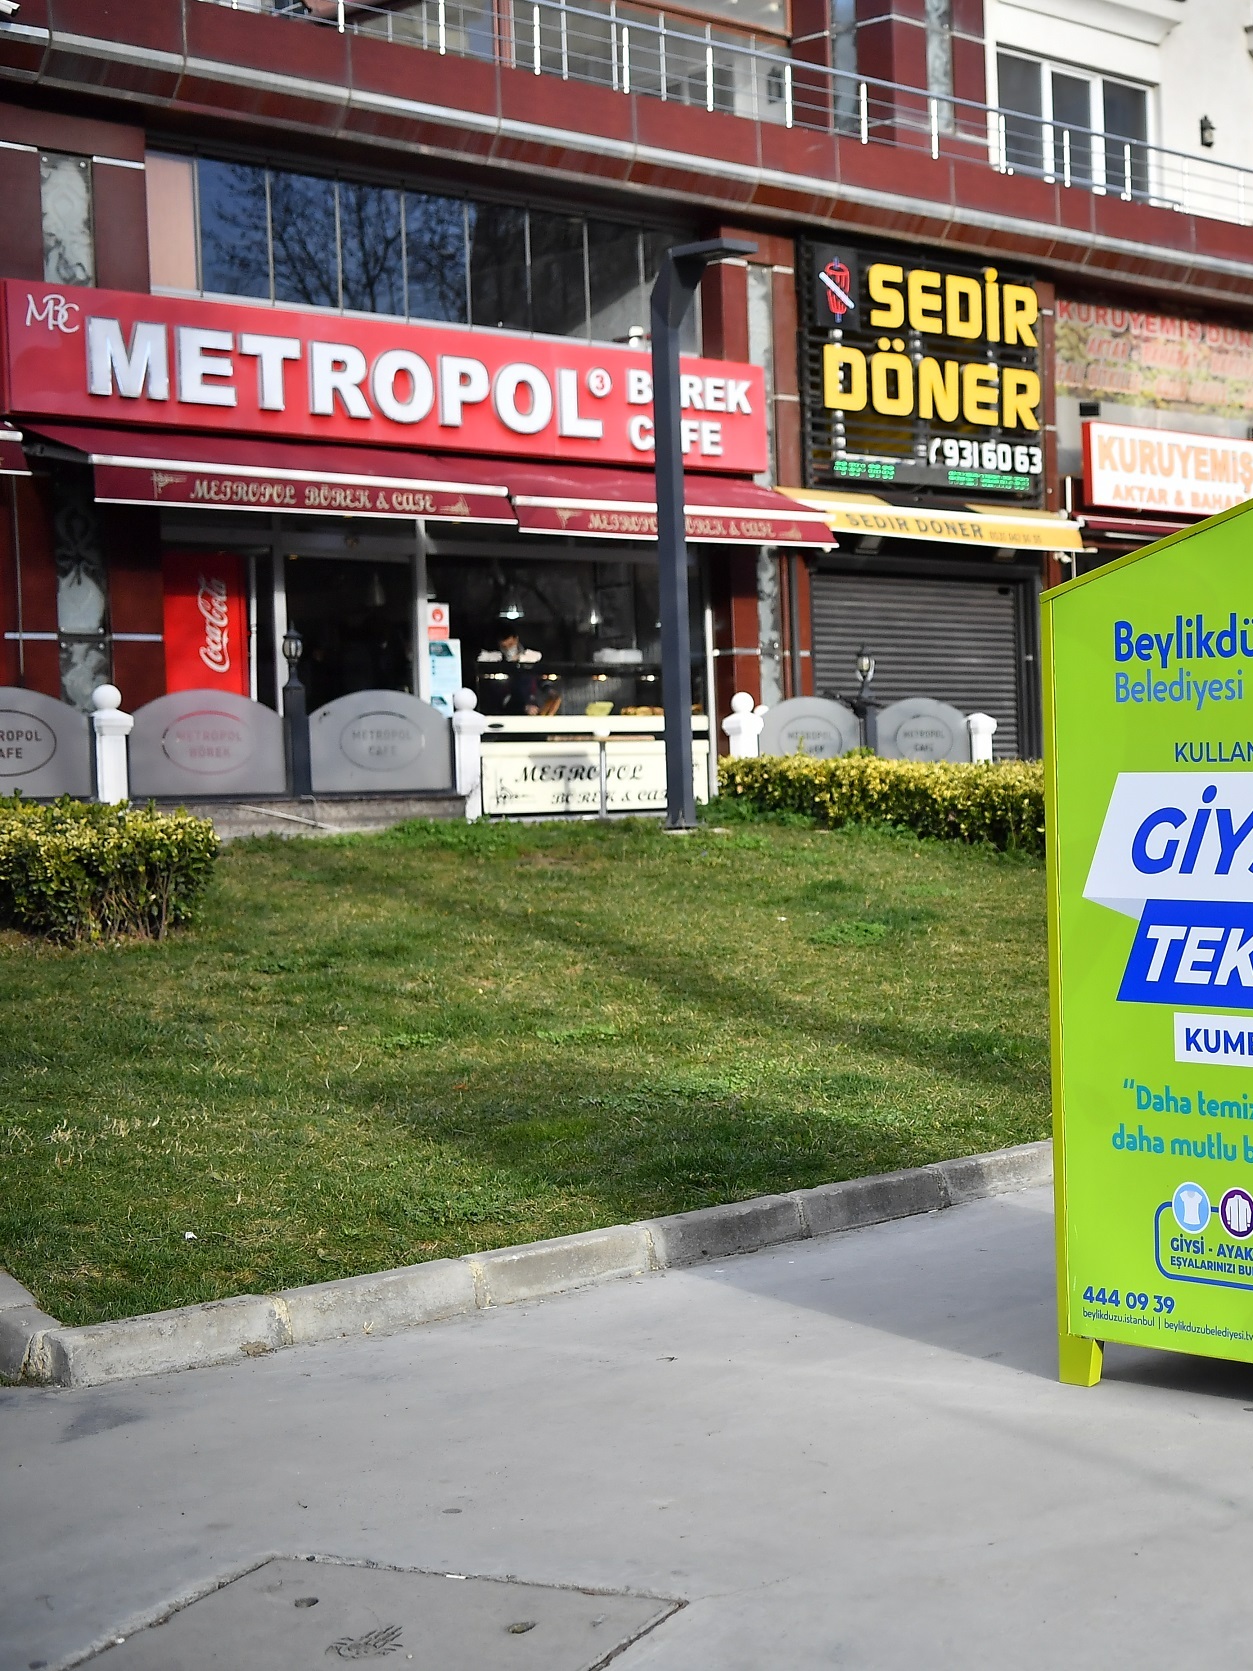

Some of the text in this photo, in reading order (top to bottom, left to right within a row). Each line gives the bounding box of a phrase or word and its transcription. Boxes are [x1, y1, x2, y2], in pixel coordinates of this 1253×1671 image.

[868, 263, 1039, 347] SEDİR
[86, 315, 603, 440] METROPOL
[627, 368, 752, 415] BREK
[823, 337, 1041, 431] DÖNER
[629, 414, 723, 456] CFE
[190, 479, 297, 505] METROPOL
[1112, 484, 1169, 505] AKTAR
[1115, 669, 1244, 710] Belediyesi
[0, 730, 42, 742] ROPOL
[1111, 1123, 1165, 1154] daha
[1170, 1132, 1238, 1162] mutlu
[1170, 1234, 1205, 1255] GİYSİ
[1170, 1256, 1236, 1275] EŞYALARINIZI
[1082, 1285, 1175, 1314] 444 09 39
[1082, 1307, 1155, 1327] beylikduzu.istanbul
[1164, 1317, 1253, 1341] beylikduzubelediyesi.tv
